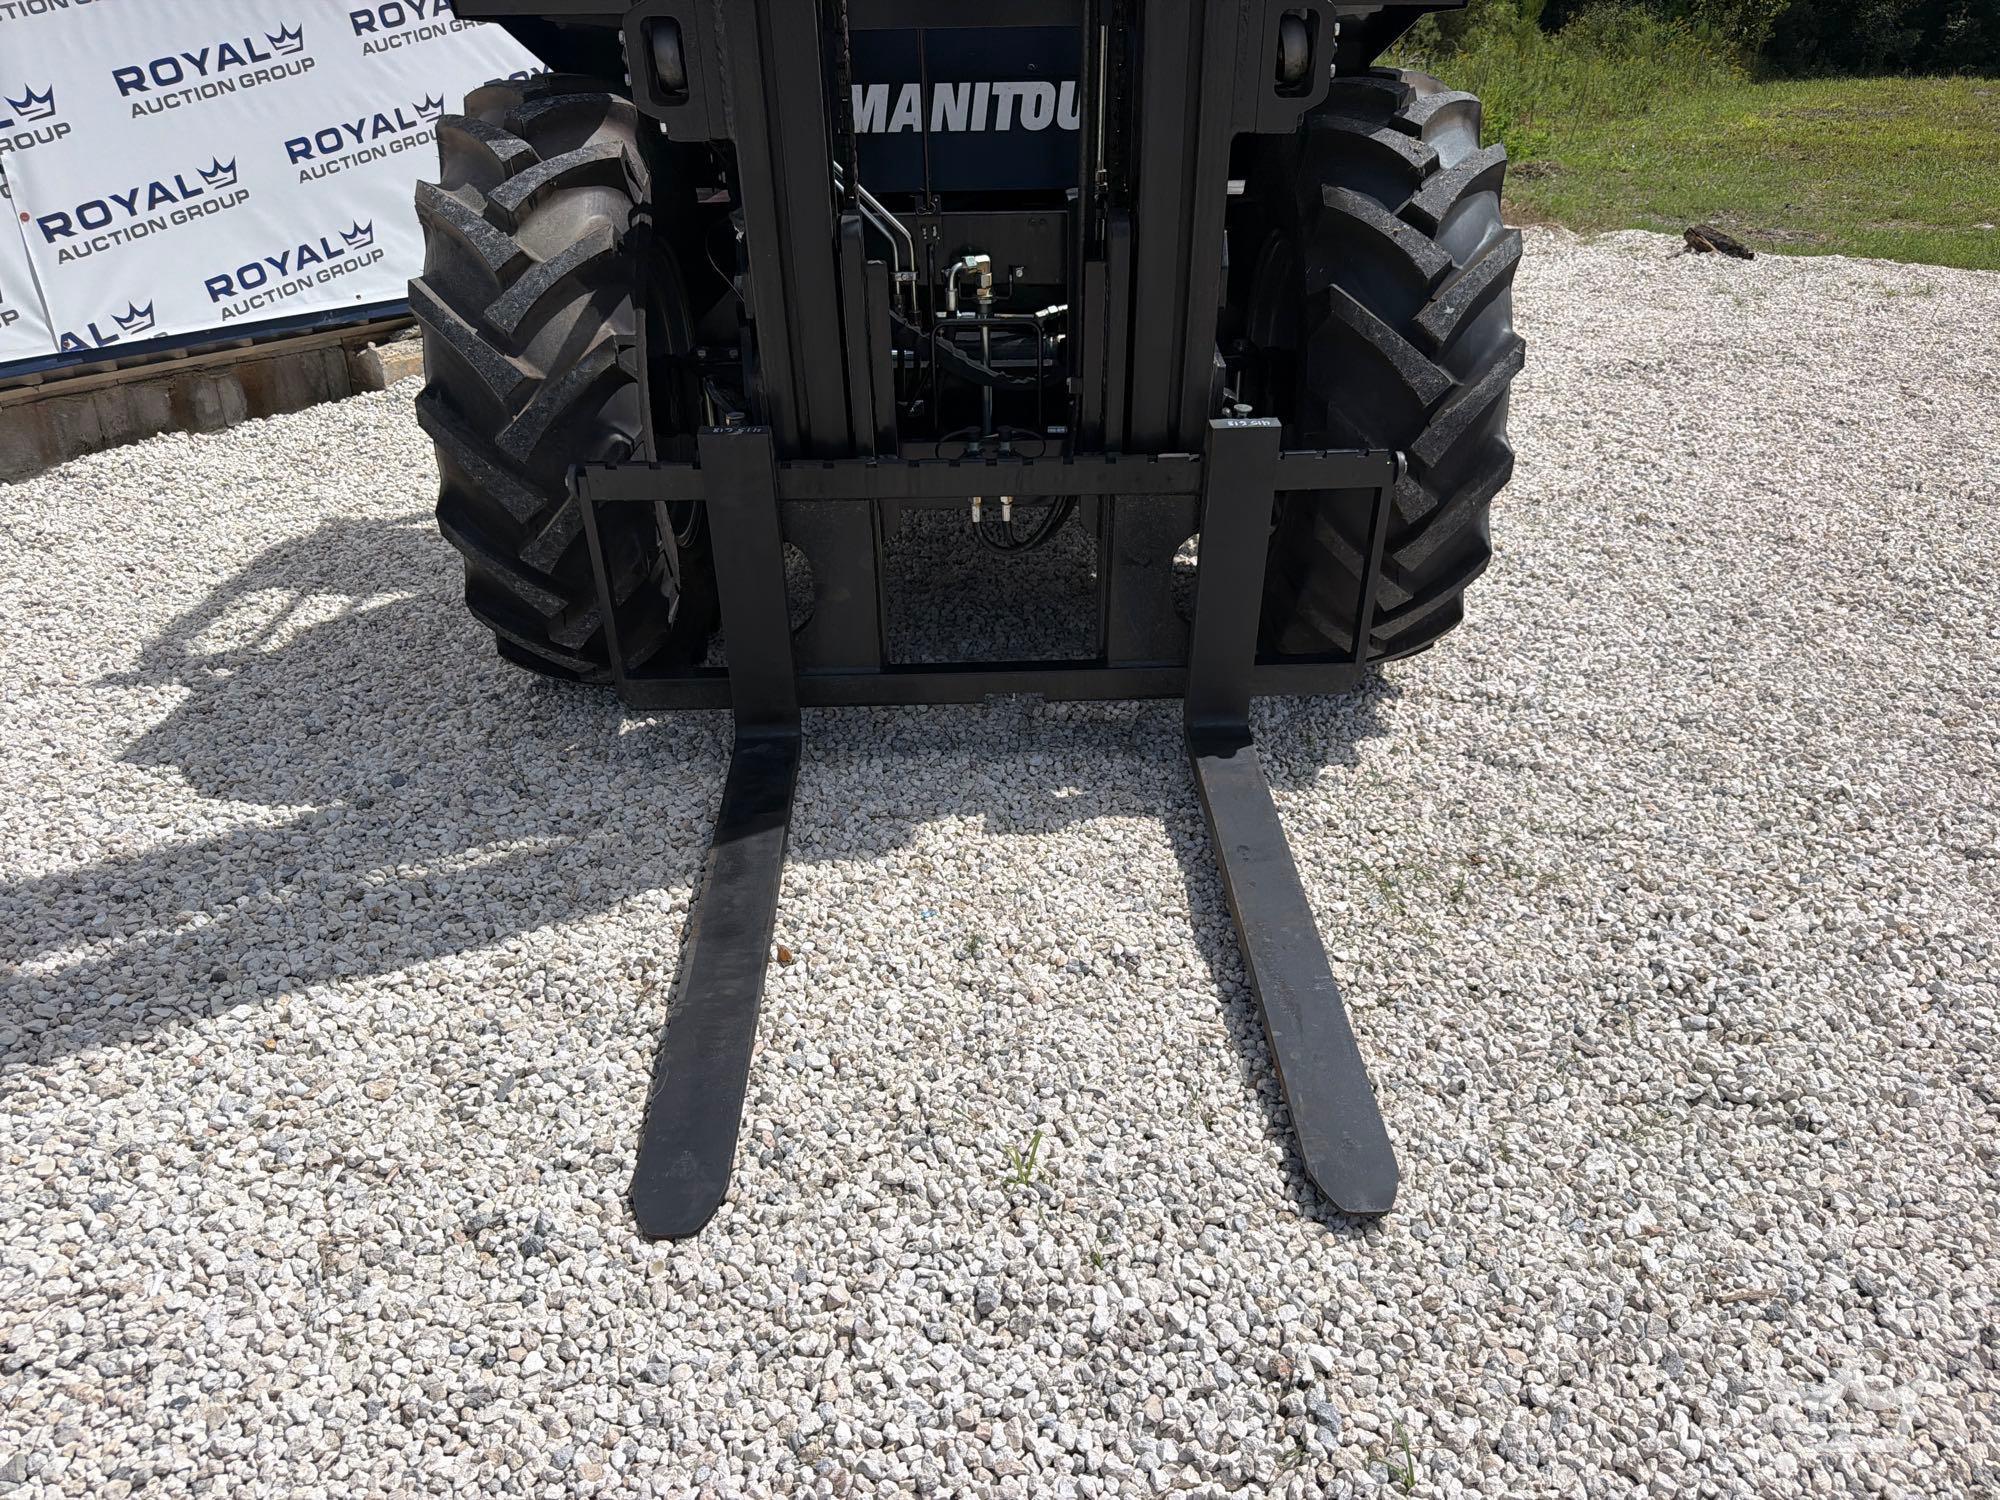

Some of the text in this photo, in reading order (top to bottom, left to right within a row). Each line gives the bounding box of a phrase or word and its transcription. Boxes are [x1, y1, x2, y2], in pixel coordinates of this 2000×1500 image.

[0, 0, 70, 20] TION
[362, 22, 448, 57] AUCTION
[112, 37, 272, 97] ROYAL
[131, 57, 316, 119] AUCTION GROUP
[284, 107, 418, 165] ROYAL
[851, 80, 1081, 134] MANITOU
[0, 122, 72, 155] ROUP
[299, 129, 438, 184] AUCTION GROU
[36, 174, 205, 244] ROYAL
[58, 188, 250, 265] AUCTION GROUP
[204, 237, 346, 303] ROYAL
[221, 248, 385, 321] AUCTION GROUP
